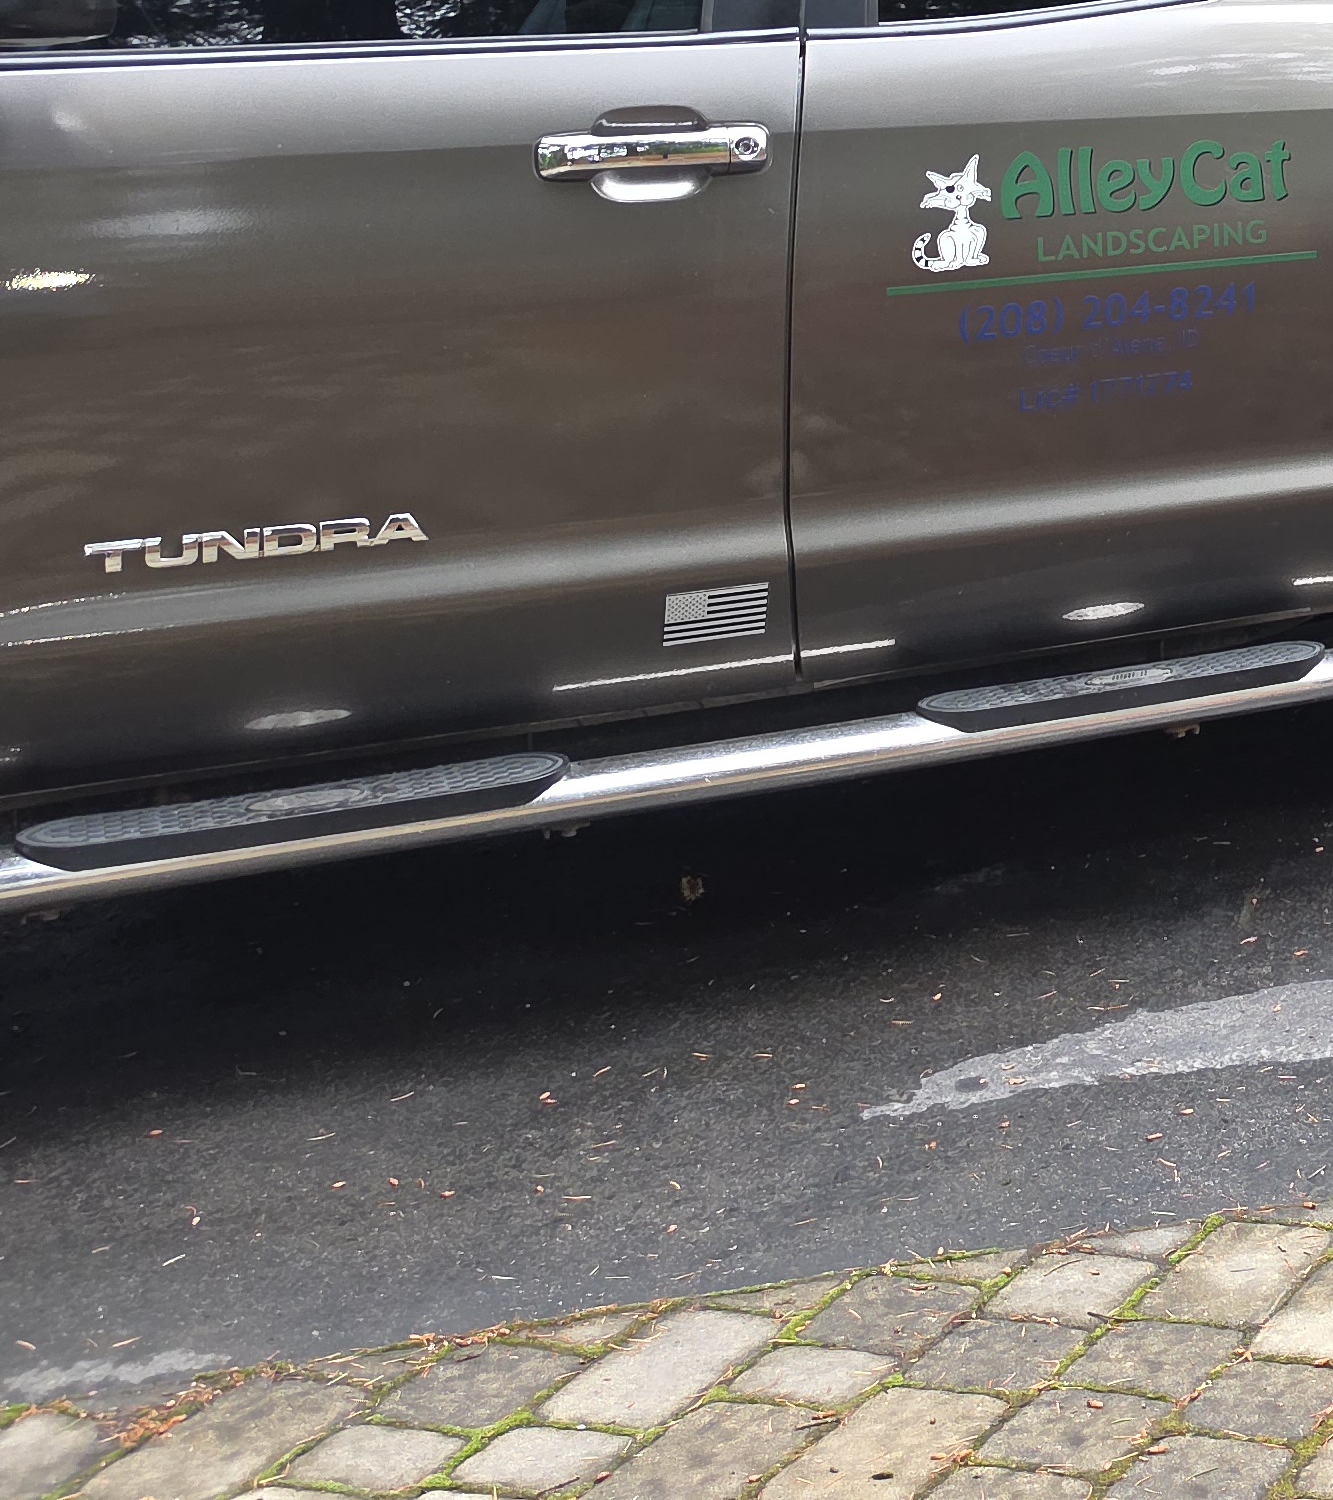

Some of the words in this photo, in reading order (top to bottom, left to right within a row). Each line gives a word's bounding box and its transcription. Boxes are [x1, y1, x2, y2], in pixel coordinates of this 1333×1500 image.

[1037, 220, 1267, 261] LANDSCAPING
[959, 294, 1065, 345] (208)
[1081, 280, 1257, 331] 204-8241
[84, 512, 429, 574] TUNDRA
